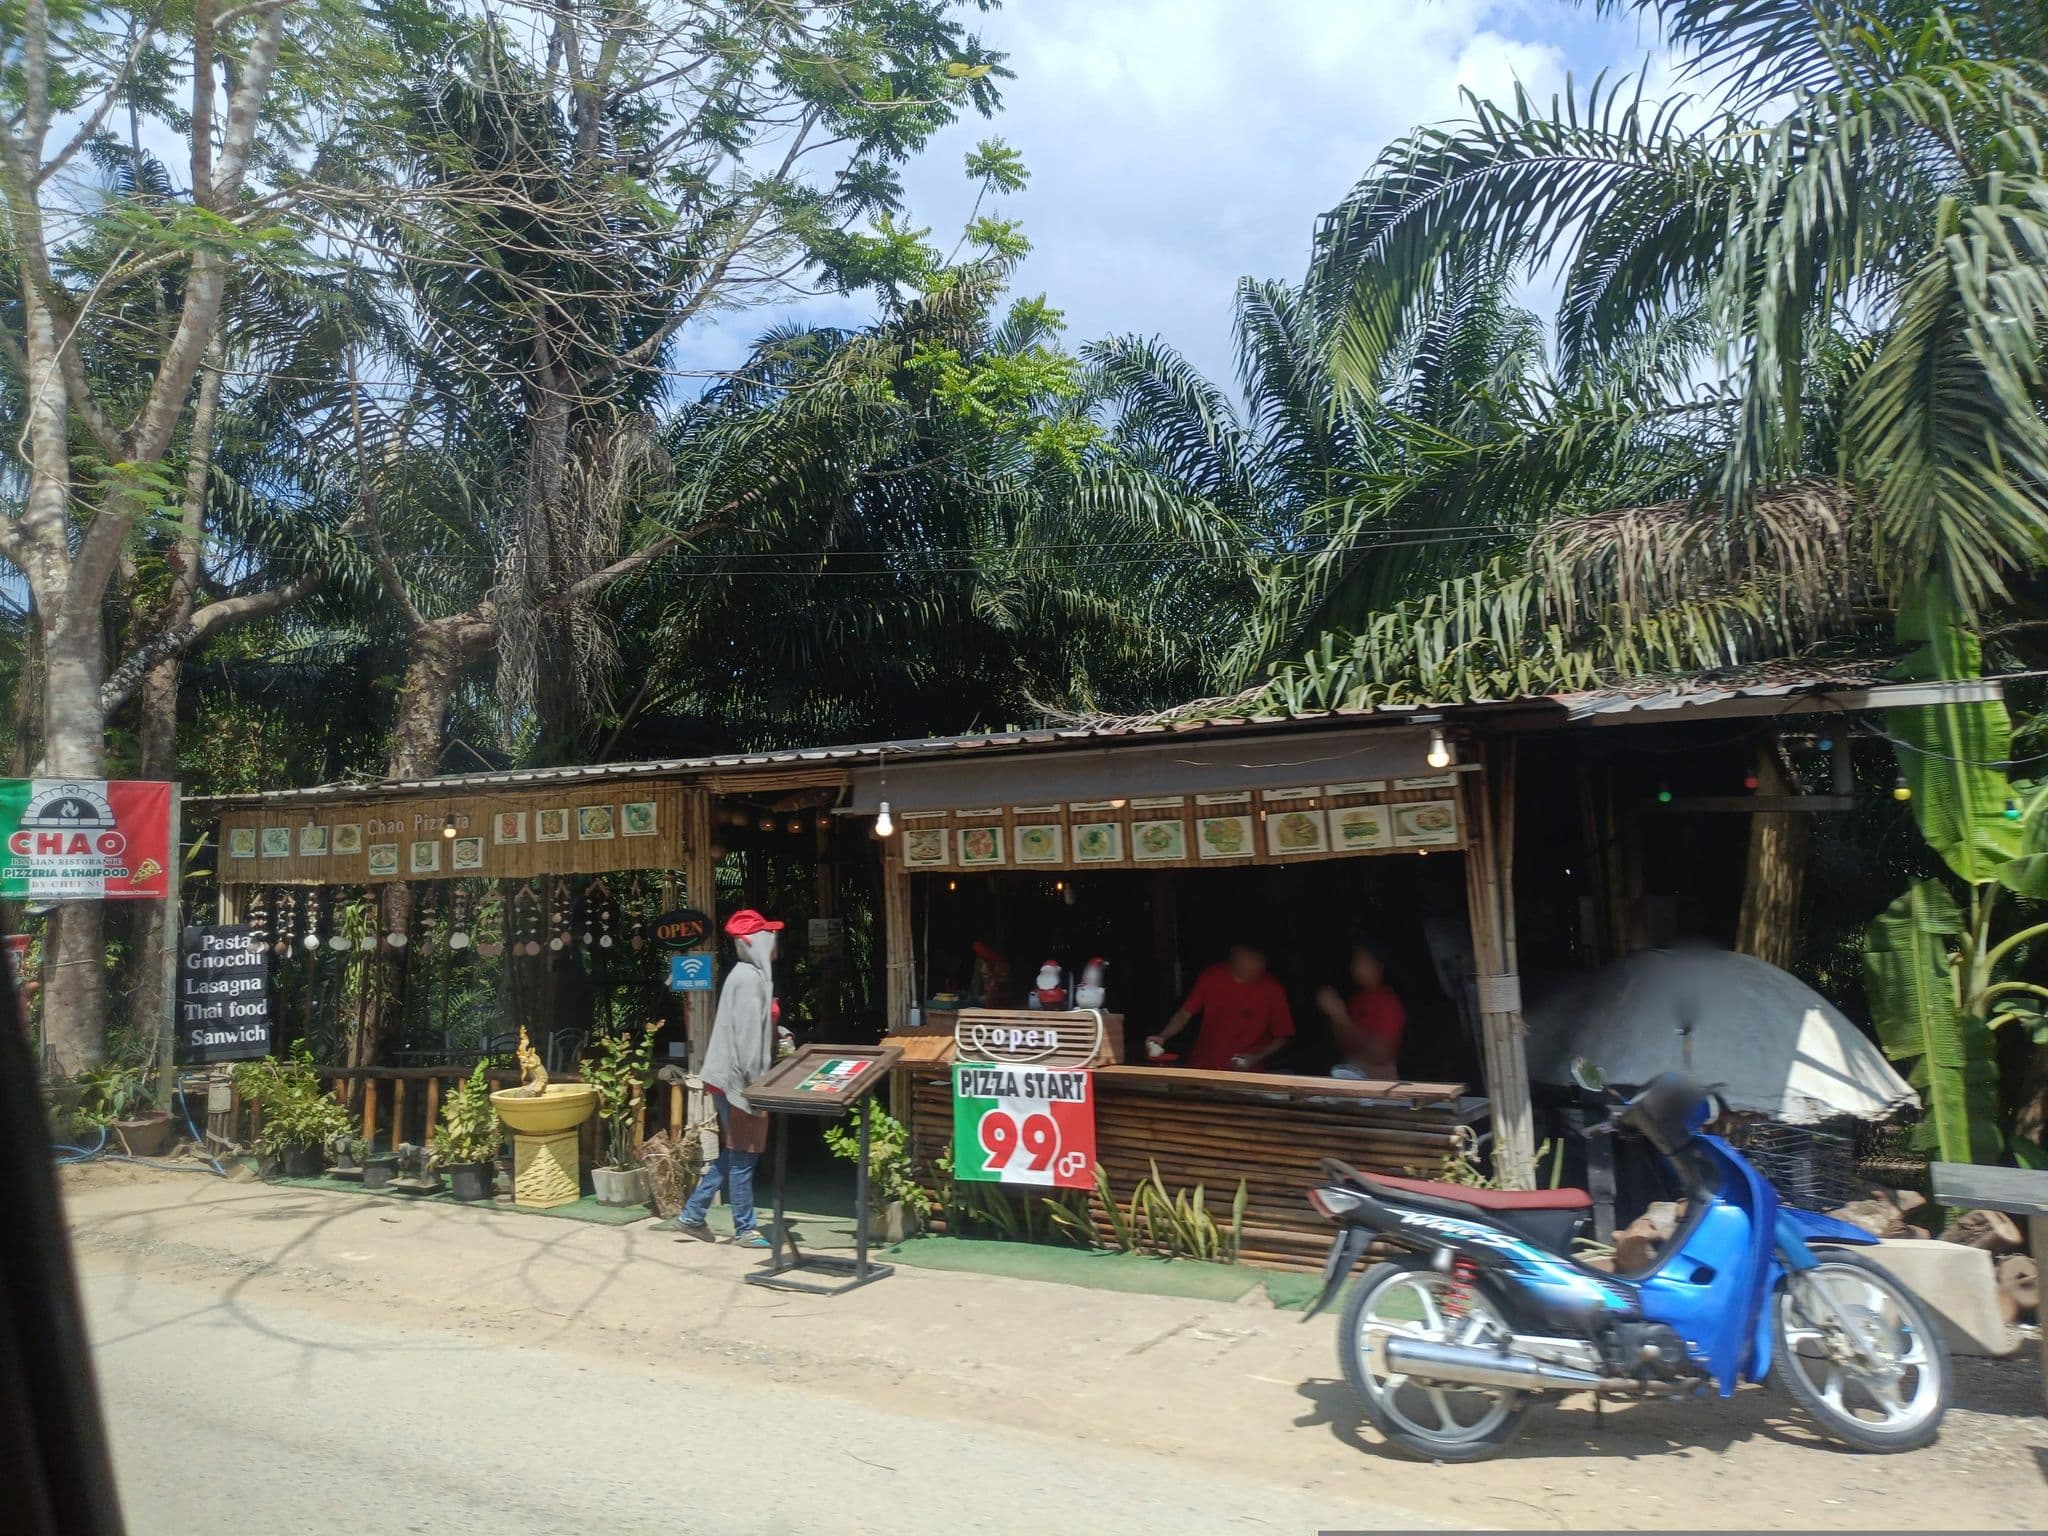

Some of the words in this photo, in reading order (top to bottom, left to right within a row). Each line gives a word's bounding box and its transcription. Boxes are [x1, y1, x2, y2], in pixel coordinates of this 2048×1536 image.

[368, 818, 405, 836] Chao
[414, 812, 470, 832] Pizzia
[8, 831, 126, 857] CHAO
[11, 858, 55, 866] ITALIAN
[58, 857, 123, 866] RISTORANTE
[3, 868, 58, 879] PIZZERIA
[32, 880, 46, 889] BY
[51, 880, 84, 888] CHEF
[656, 920, 705, 940] OPEN
[202, 934, 252, 951] Pasta
[186, 950, 262, 969] Gnocchi
[185, 977, 262, 997] Lasagna
[184, 1002, 223, 1021] Thai
[229, 998, 268, 1018] food
[191, 1025, 266, 1046] Sanwich
[991, 1026, 1059, 1052] open
[959, 1070, 1020, 1097] PIZZA
[1024, 1072, 1086, 1101] START
[978, 1109, 1061, 1173] 99
